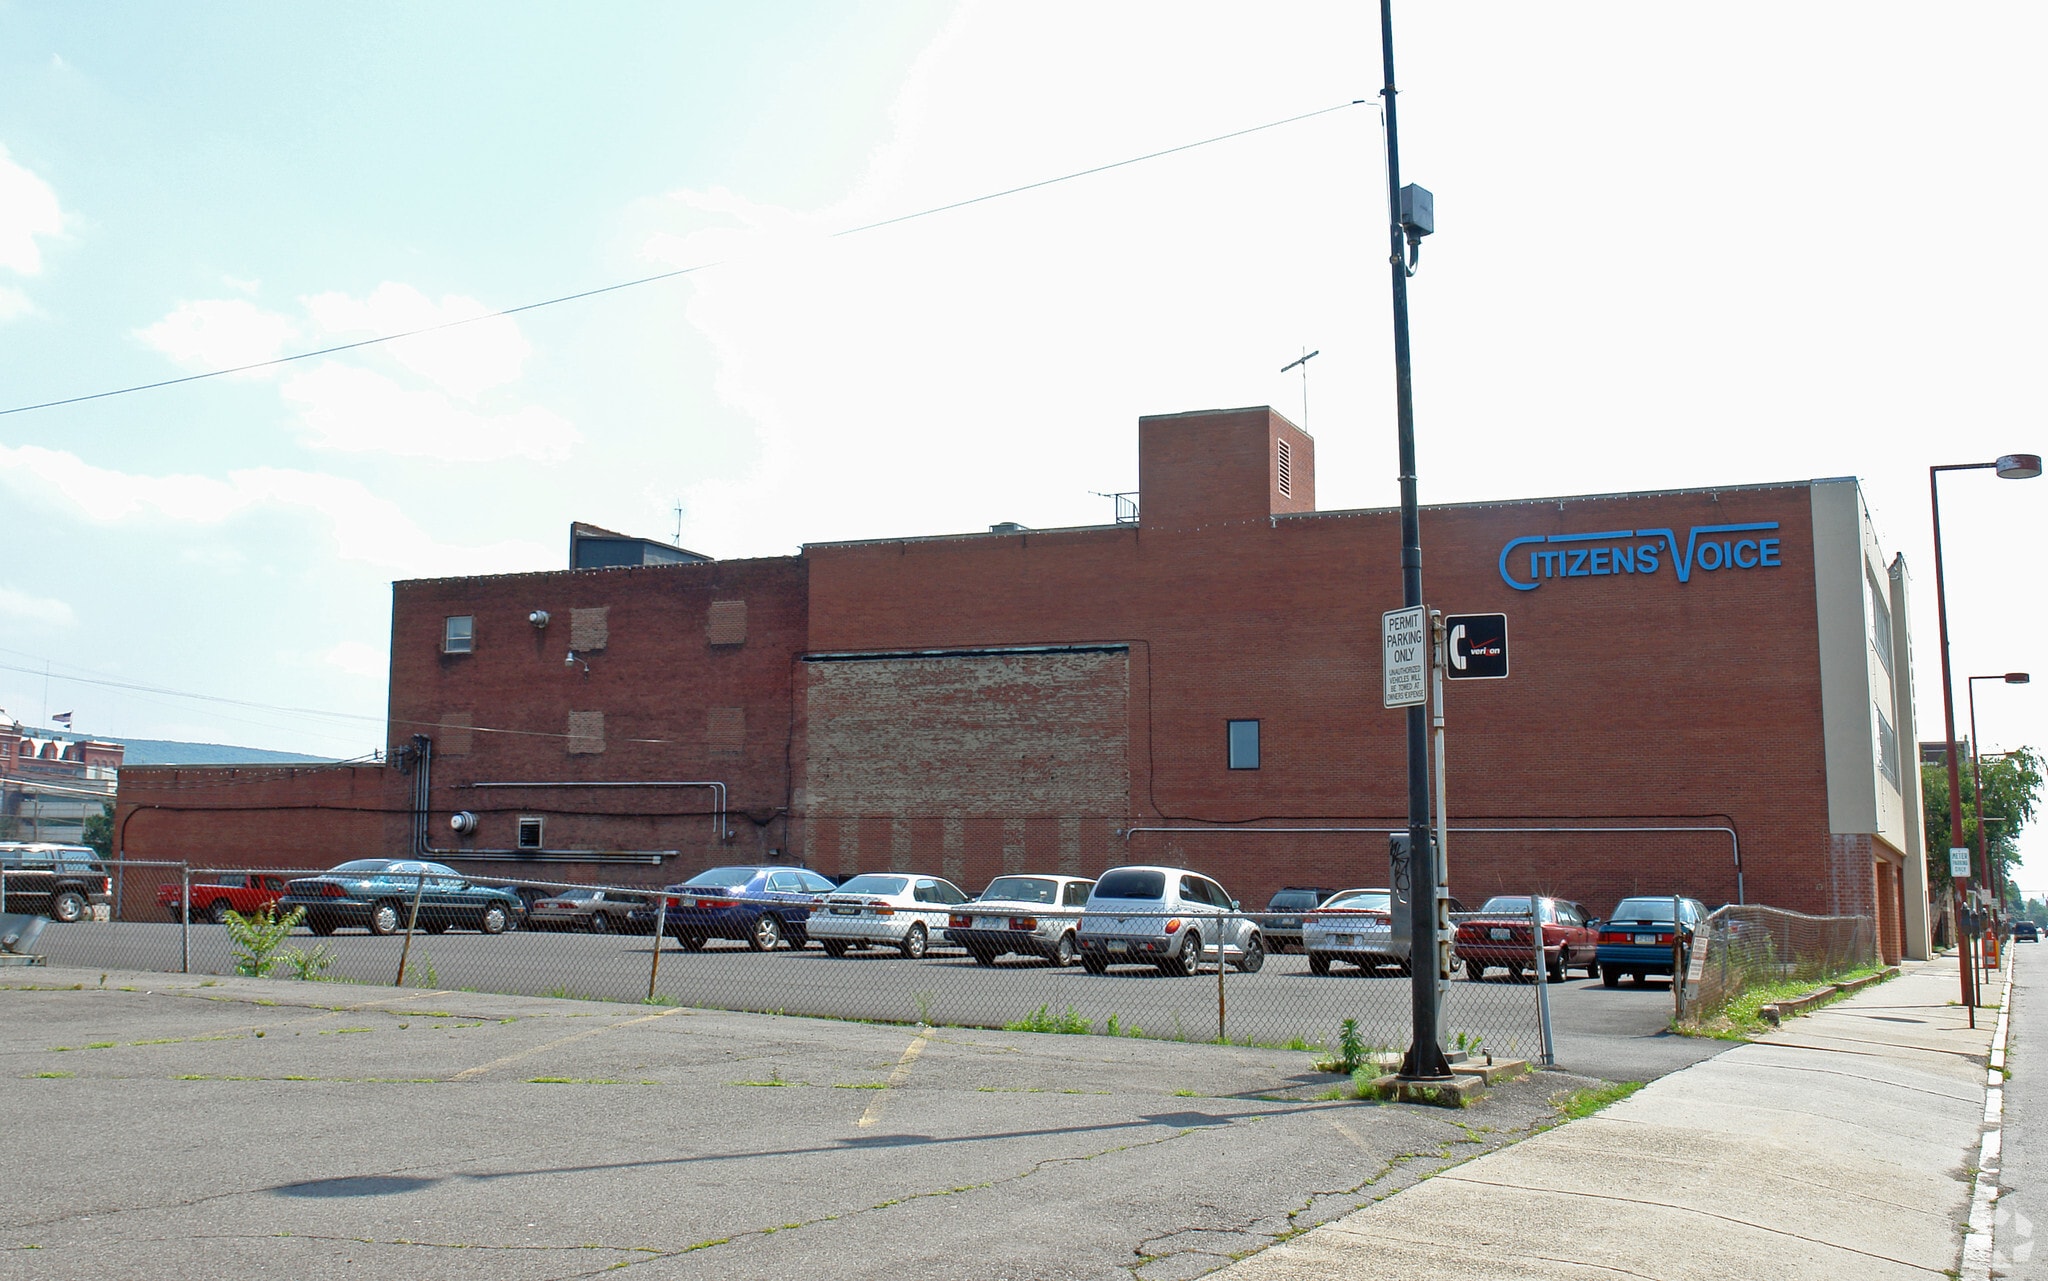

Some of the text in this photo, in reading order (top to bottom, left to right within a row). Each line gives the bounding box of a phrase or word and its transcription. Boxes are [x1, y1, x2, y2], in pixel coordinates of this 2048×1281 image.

[1637, 521, 1781, 583] VOICE
[1389, 613, 1418, 631] PERMIT
[1387, 630, 1421, 648] PARKING
[1394, 647, 1414, 663] ONLY
[1470, 646, 1500, 656] verizon
[1389, 665, 1421, 676] UNAUTHORIZED
[1389, 673, 1421, 684] VEHICLES WILL
[1390, 684, 1396, 692] BE
[1398, 683, 1412, 691] TOWED
